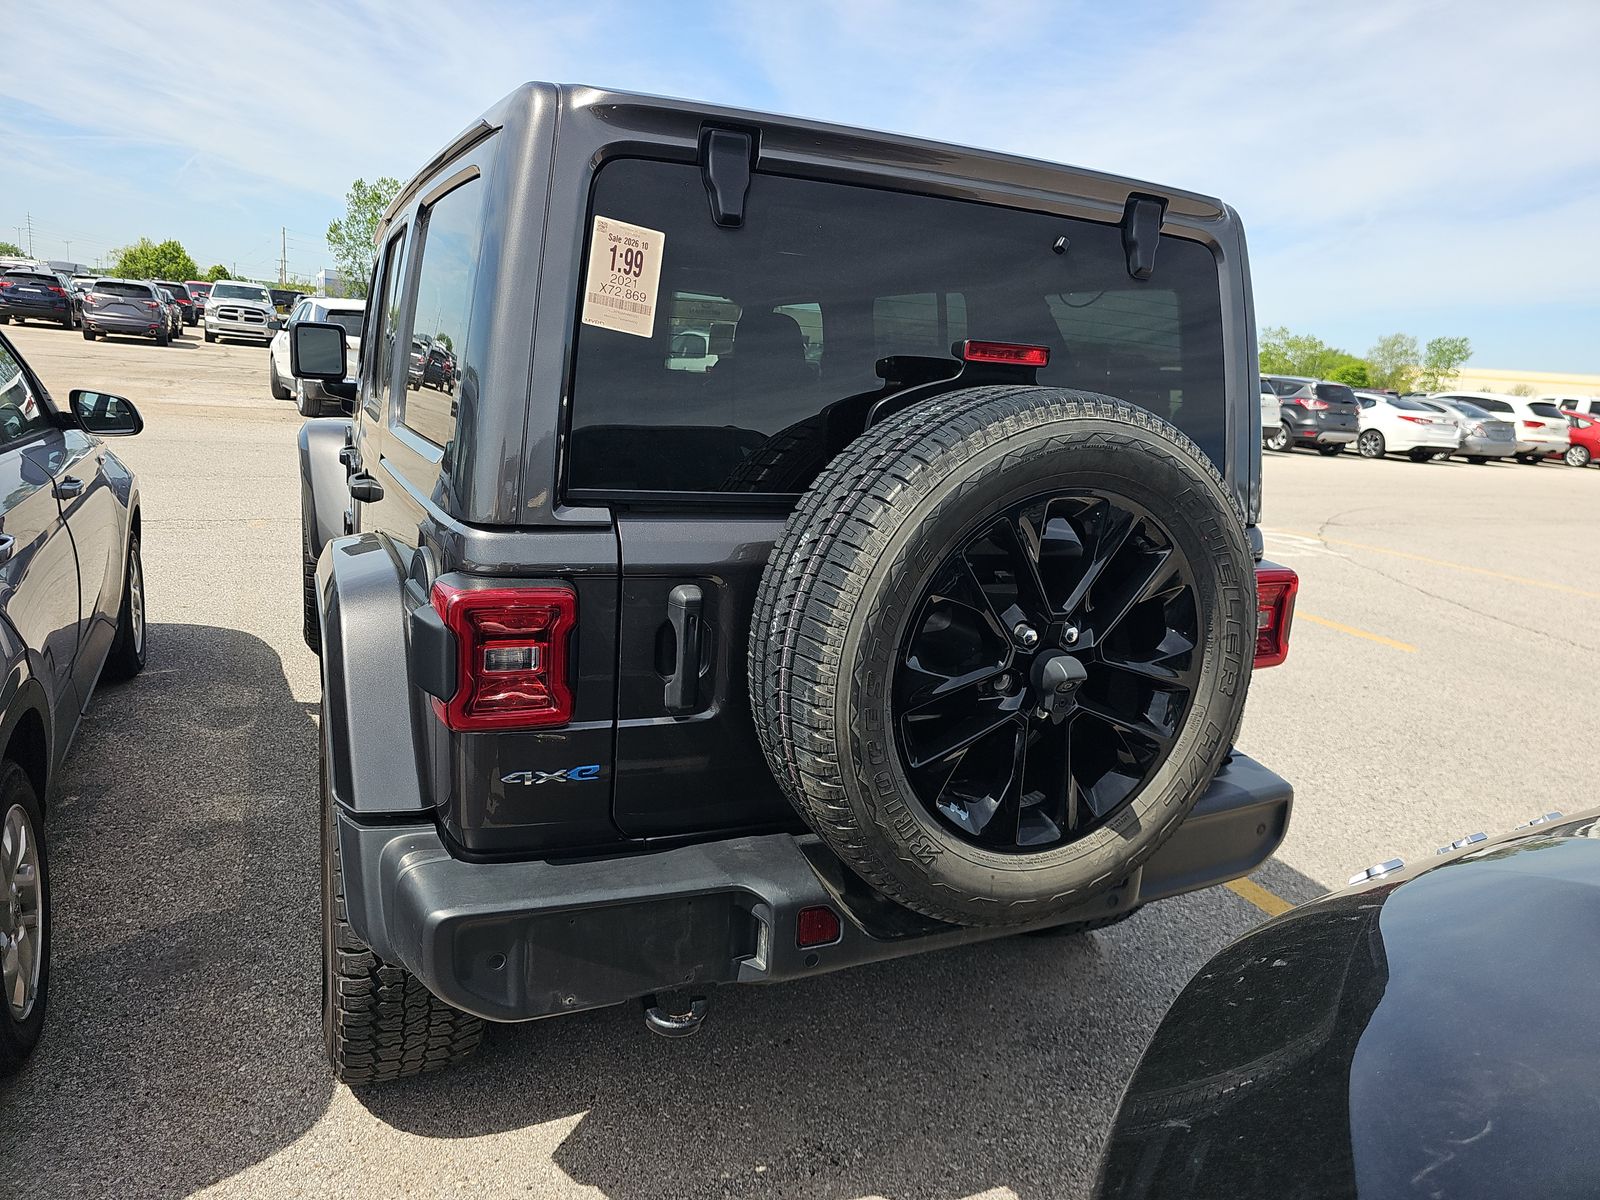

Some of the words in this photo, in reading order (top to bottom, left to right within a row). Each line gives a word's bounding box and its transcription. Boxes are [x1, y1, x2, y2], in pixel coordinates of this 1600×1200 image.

[608, 233, 622, 244] Sale
[624, 237, 640, 248] 2026
[641, 241, 649, 251] 10
[609, 245, 644, 278] 1:99
[610, 273, 638, 289] 2021
[599, 282, 647, 302] X72,869
